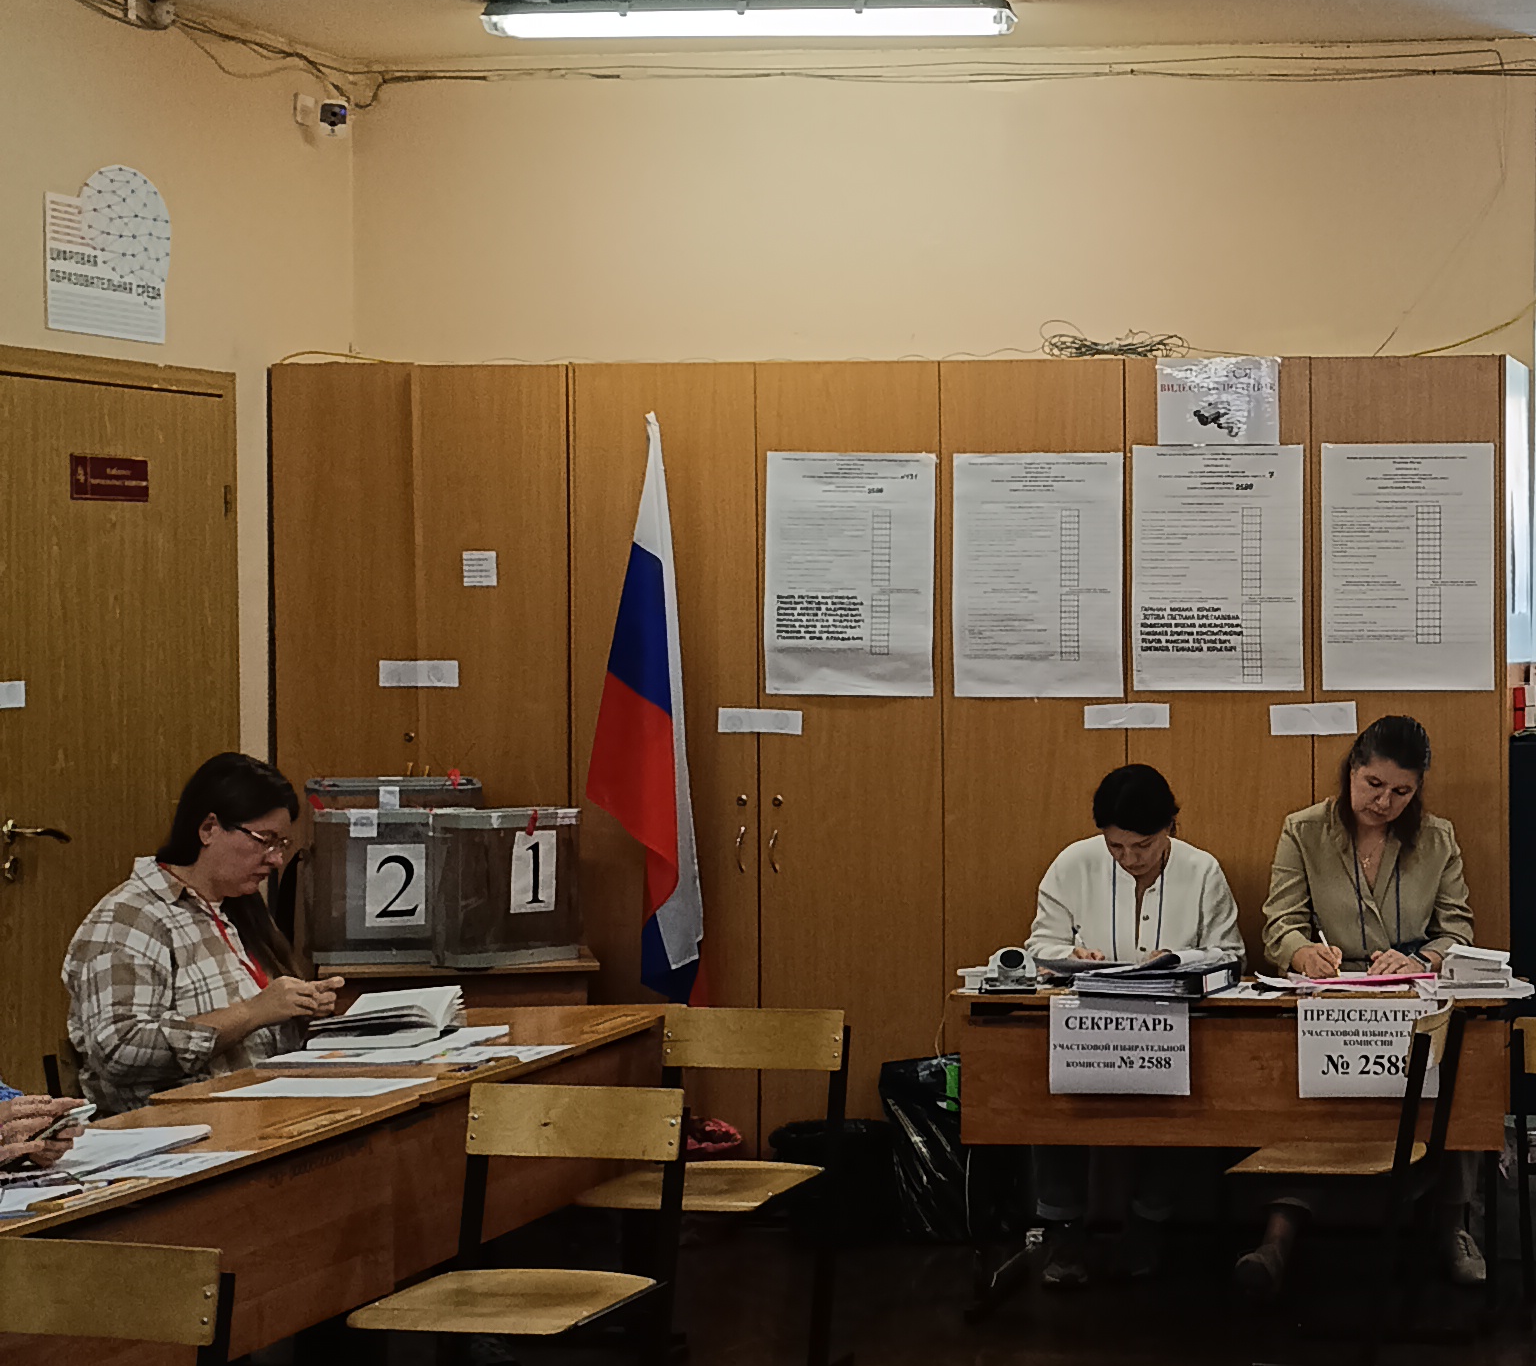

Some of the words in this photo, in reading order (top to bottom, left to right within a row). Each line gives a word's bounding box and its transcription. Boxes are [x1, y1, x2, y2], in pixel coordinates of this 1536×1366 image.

[49, 268, 133, 295] ОБРАЗОВАТЕЛЬНАЯ
[525, 841, 546, 905] 1
[375, 854, 419, 919] 2
[1064, 1015, 1174, 1032] СЕКРЕТАРЬ
[1303, 1008, 1428, 1024] ПРЕДСЕДАТЕЛ
[1301, 1028, 1360, 1038] УЧАСТКОВОЙ
[1361, 1029, 1413, 1038] ИЗБИРАТЕЛ
[1052, 1043, 1111, 1051] УЧАСТКОВОЙ
[1112, 1044, 1186, 1053] ИЗБИРАТЕЛЬНОЙ
[1117, 1055, 1135, 1069] №
[1138, 1056, 1172, 1070] 2588
[1321, 1054, 1351, 1076] №
